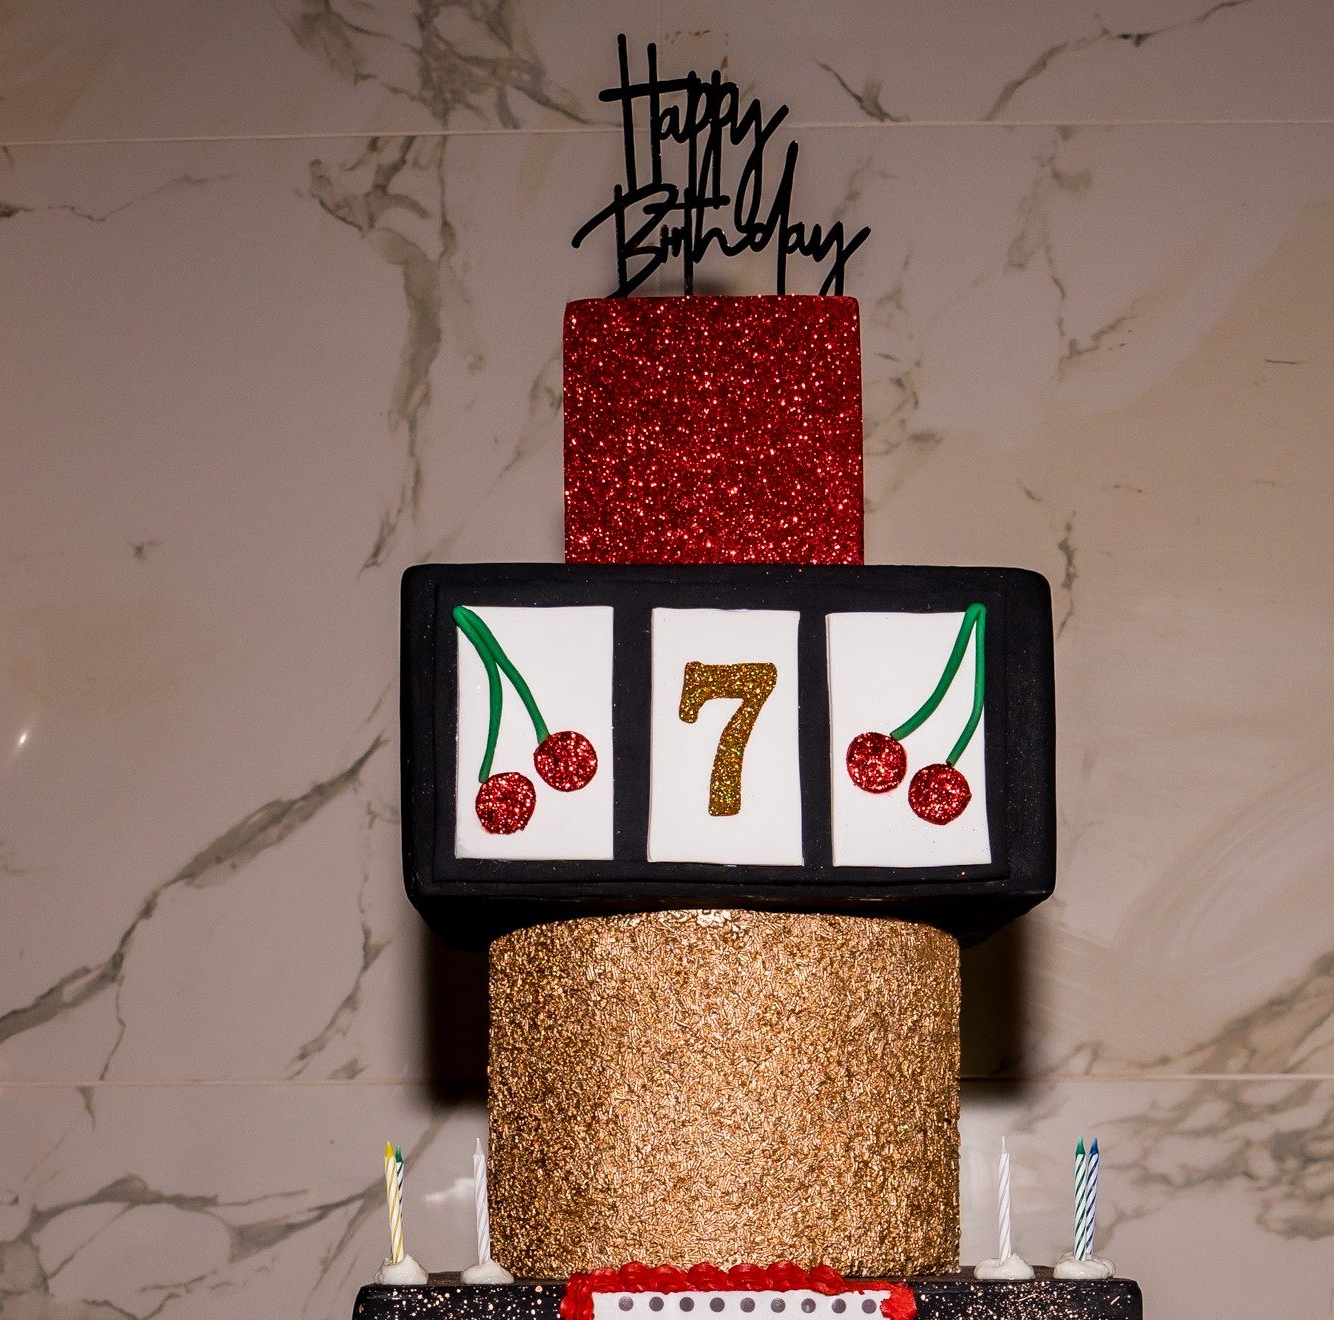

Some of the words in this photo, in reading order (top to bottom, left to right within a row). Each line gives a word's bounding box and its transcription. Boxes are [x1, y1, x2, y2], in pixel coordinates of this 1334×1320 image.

[598, 33, 789, 236] Happy
[571, 139, 871, 298] Birthday
[678, 660, 777, 816] 7
